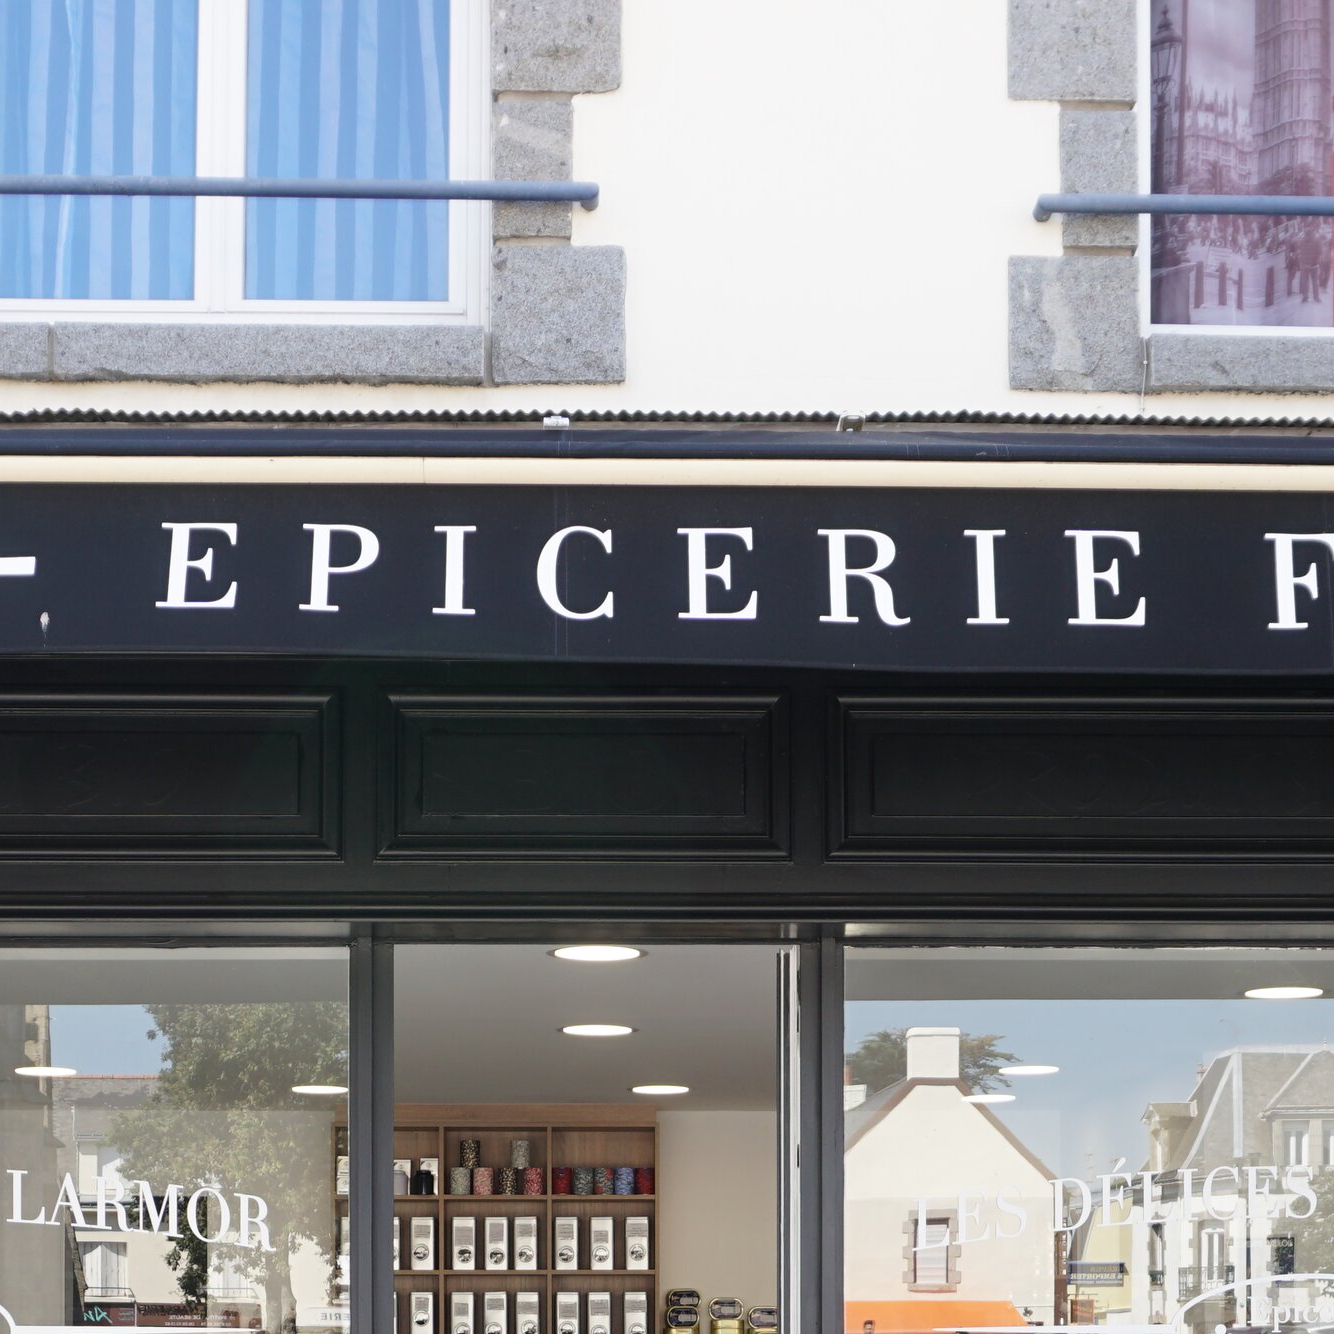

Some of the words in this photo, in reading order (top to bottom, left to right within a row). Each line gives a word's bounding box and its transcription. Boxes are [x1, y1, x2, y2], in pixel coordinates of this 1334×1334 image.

[155, 521, 1146, 627] EPICERIE
[6, 1171, 277, 1252] LARMOR
[913, 1184, 1028, 1252] LES
[1049, 1157, 1318, 1233] DÉLICES
